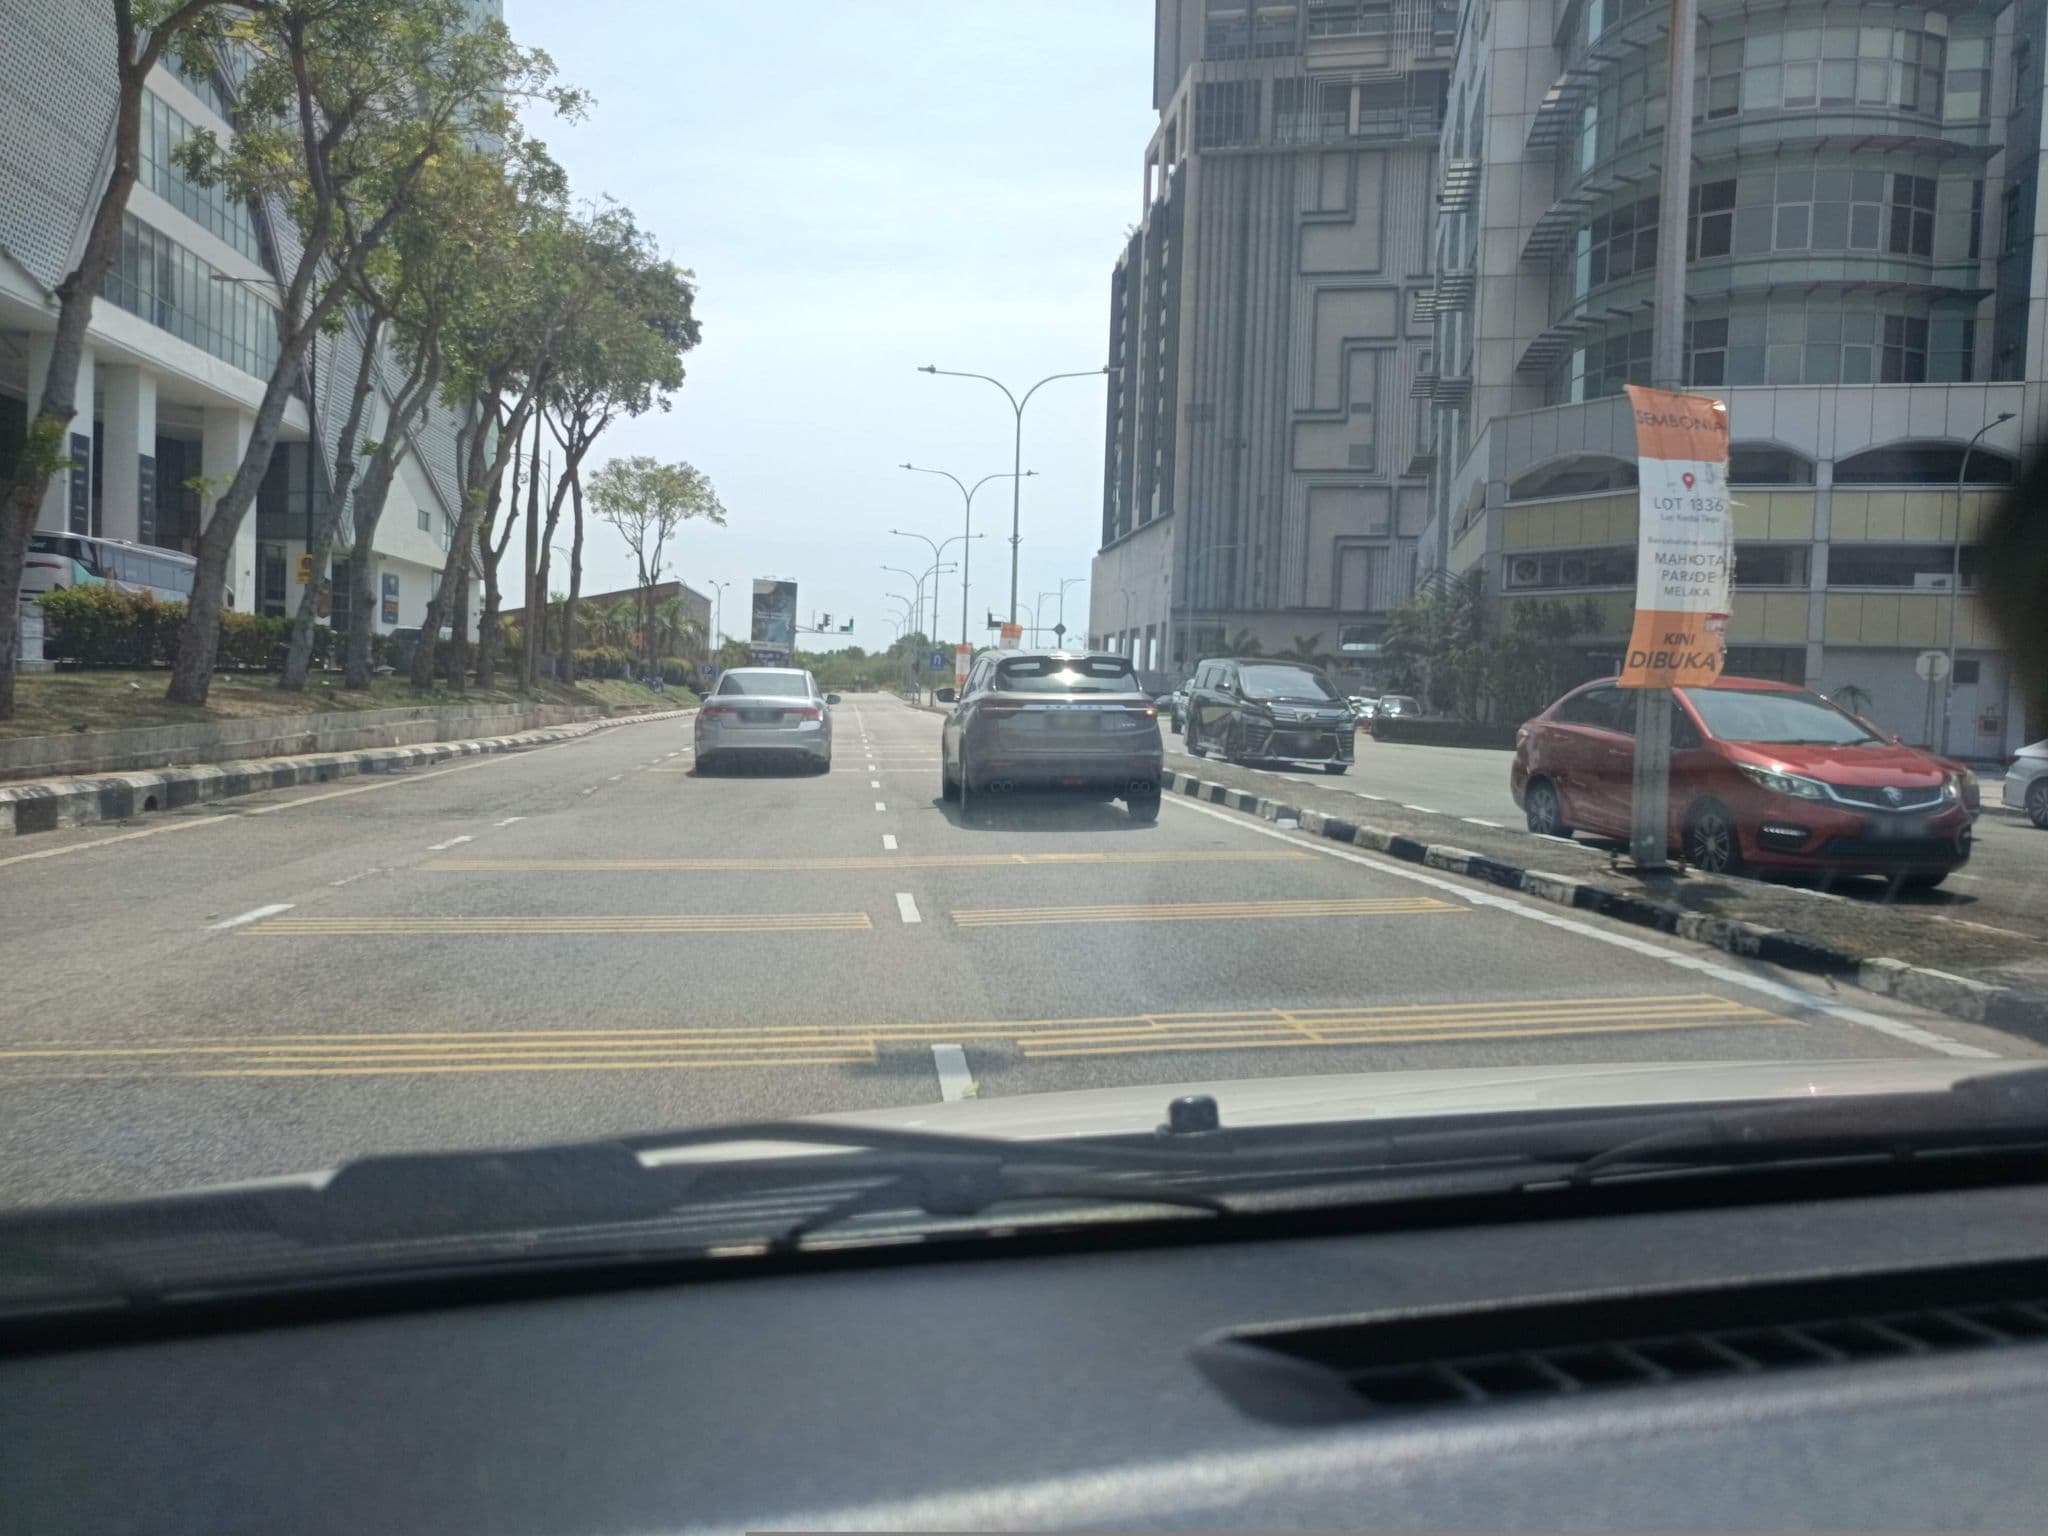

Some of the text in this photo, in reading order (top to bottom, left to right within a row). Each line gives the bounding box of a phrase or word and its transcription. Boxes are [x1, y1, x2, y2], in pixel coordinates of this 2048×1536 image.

[1636, 409, 1727, 432] SEMBONIA
[1654, 496, 1724, 513] LOT 1336
[1664, 633, 1696, 646] KINI
[1629, 650, 1717, 673] DIBUKA
